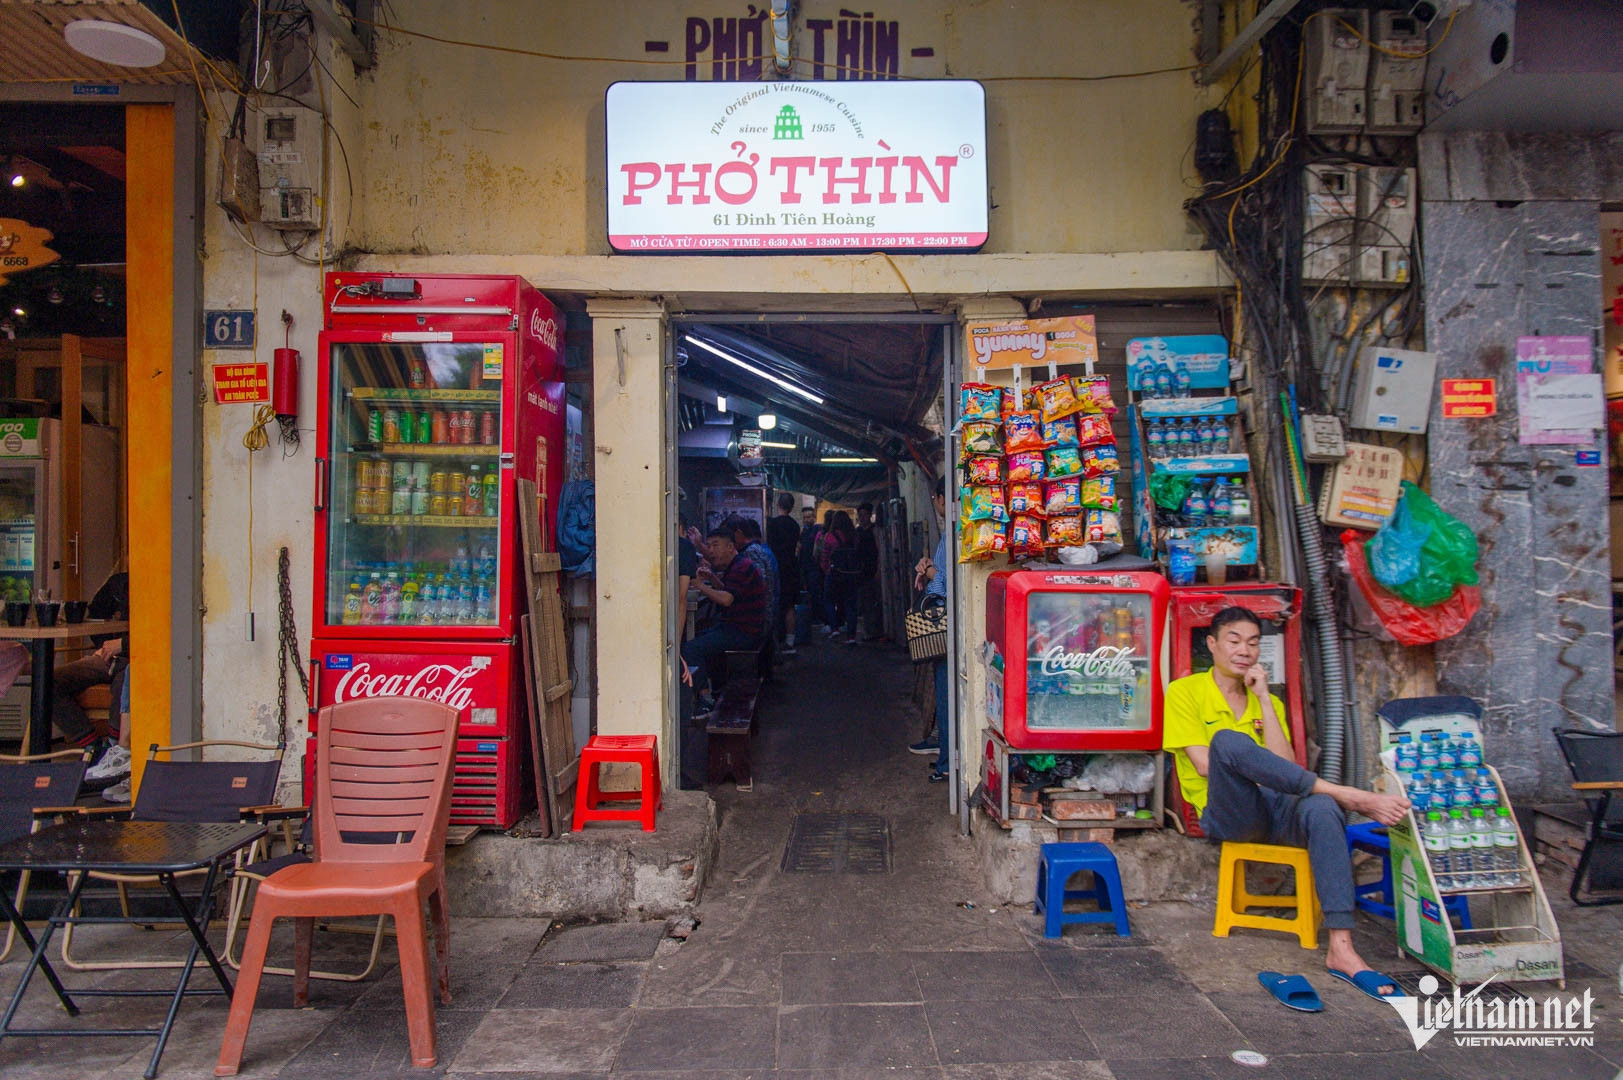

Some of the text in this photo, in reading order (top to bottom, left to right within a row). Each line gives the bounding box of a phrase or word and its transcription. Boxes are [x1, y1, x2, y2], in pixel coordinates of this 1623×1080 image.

[710, 82, 865, 139] The Original Vietnamese Cuisine
[739, 123, 836, 134] since 1955
[620, 141, 760, 206] PHỞ
[769, 139, 958, 204] THÌN
[713, 212, 876, 228] 61 Đinh Tiên Hoàng
[630, 235, 648, 248] MỞ
[650, 235, 674, 248] CỬA
[676, 235, 692, 248] TỪ
[699, 238, 730, 247] OPEN
[732, 237, 761, 247] TIME
[768, 237, 788, 247] 6:30
[790, 237, 806, 246] AM
[816, 237, 840, 246] 13:00
[843, 237, 860, 246] PM
[871, 236, 896, 246] 17:30
[898, 236, 915, 246] PM
[923, 236, 948, 245] 22:00
[951, 236, 968, 245] PM
[214, 316, 243, 341] 61
[1041, 645, 1136, 676] Coca-Cola
[335, 663, 481, 711] Coca-Cola
